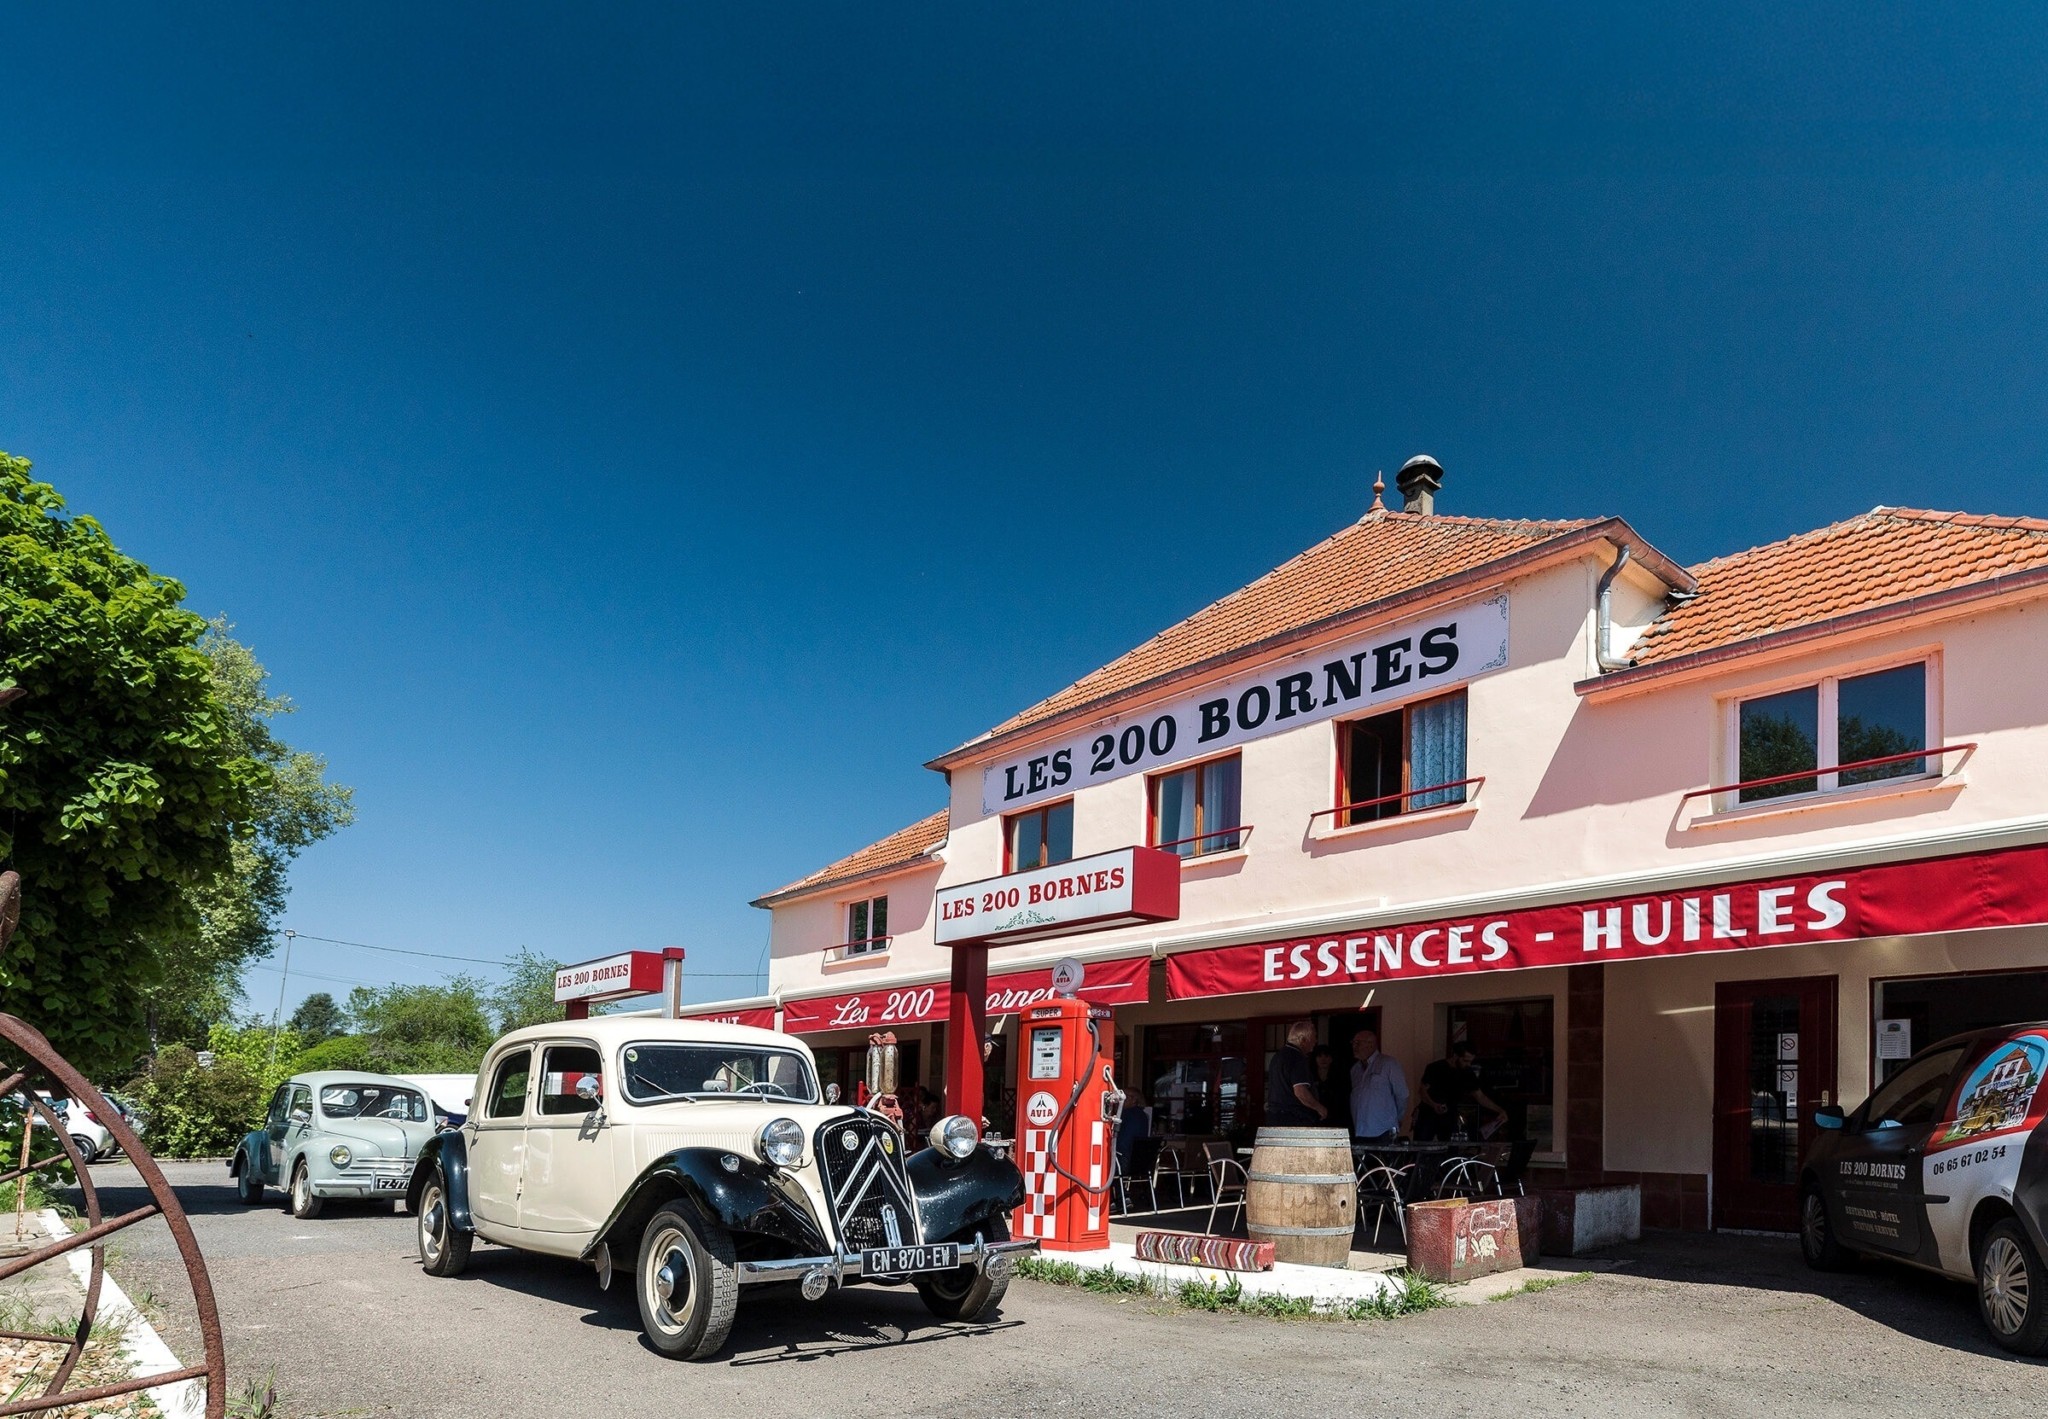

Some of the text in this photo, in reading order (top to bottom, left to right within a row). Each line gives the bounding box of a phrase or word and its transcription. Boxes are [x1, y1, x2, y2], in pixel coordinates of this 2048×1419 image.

[1003, 622, 1461, 801] LES 200 BORNES
[942, 867, 1125, 920] LES 200 BORNES
[1263, 921, 1510, 982] ESSENCES
[1582, 881, 1847, 952] HUILES
[557, 963, 629, 989] LES 200 BORNES
[1055, 976, 1071, 984] AVIA
[829, 986, 1057, 1026] Les 200 ornes
[1036, 1008, 1059, 1018] SUPER
[1030, 1108, 1054, 1118] AVIA
[1839, 1161, 1906, 1180] LES 200 BORNES
[1933, 1144, 2006, 1175] 06 65 67 02 54
[379, 1179, 410, 1189] FZ-77
[871, 1246, 950, 1272] CN-870-EW
